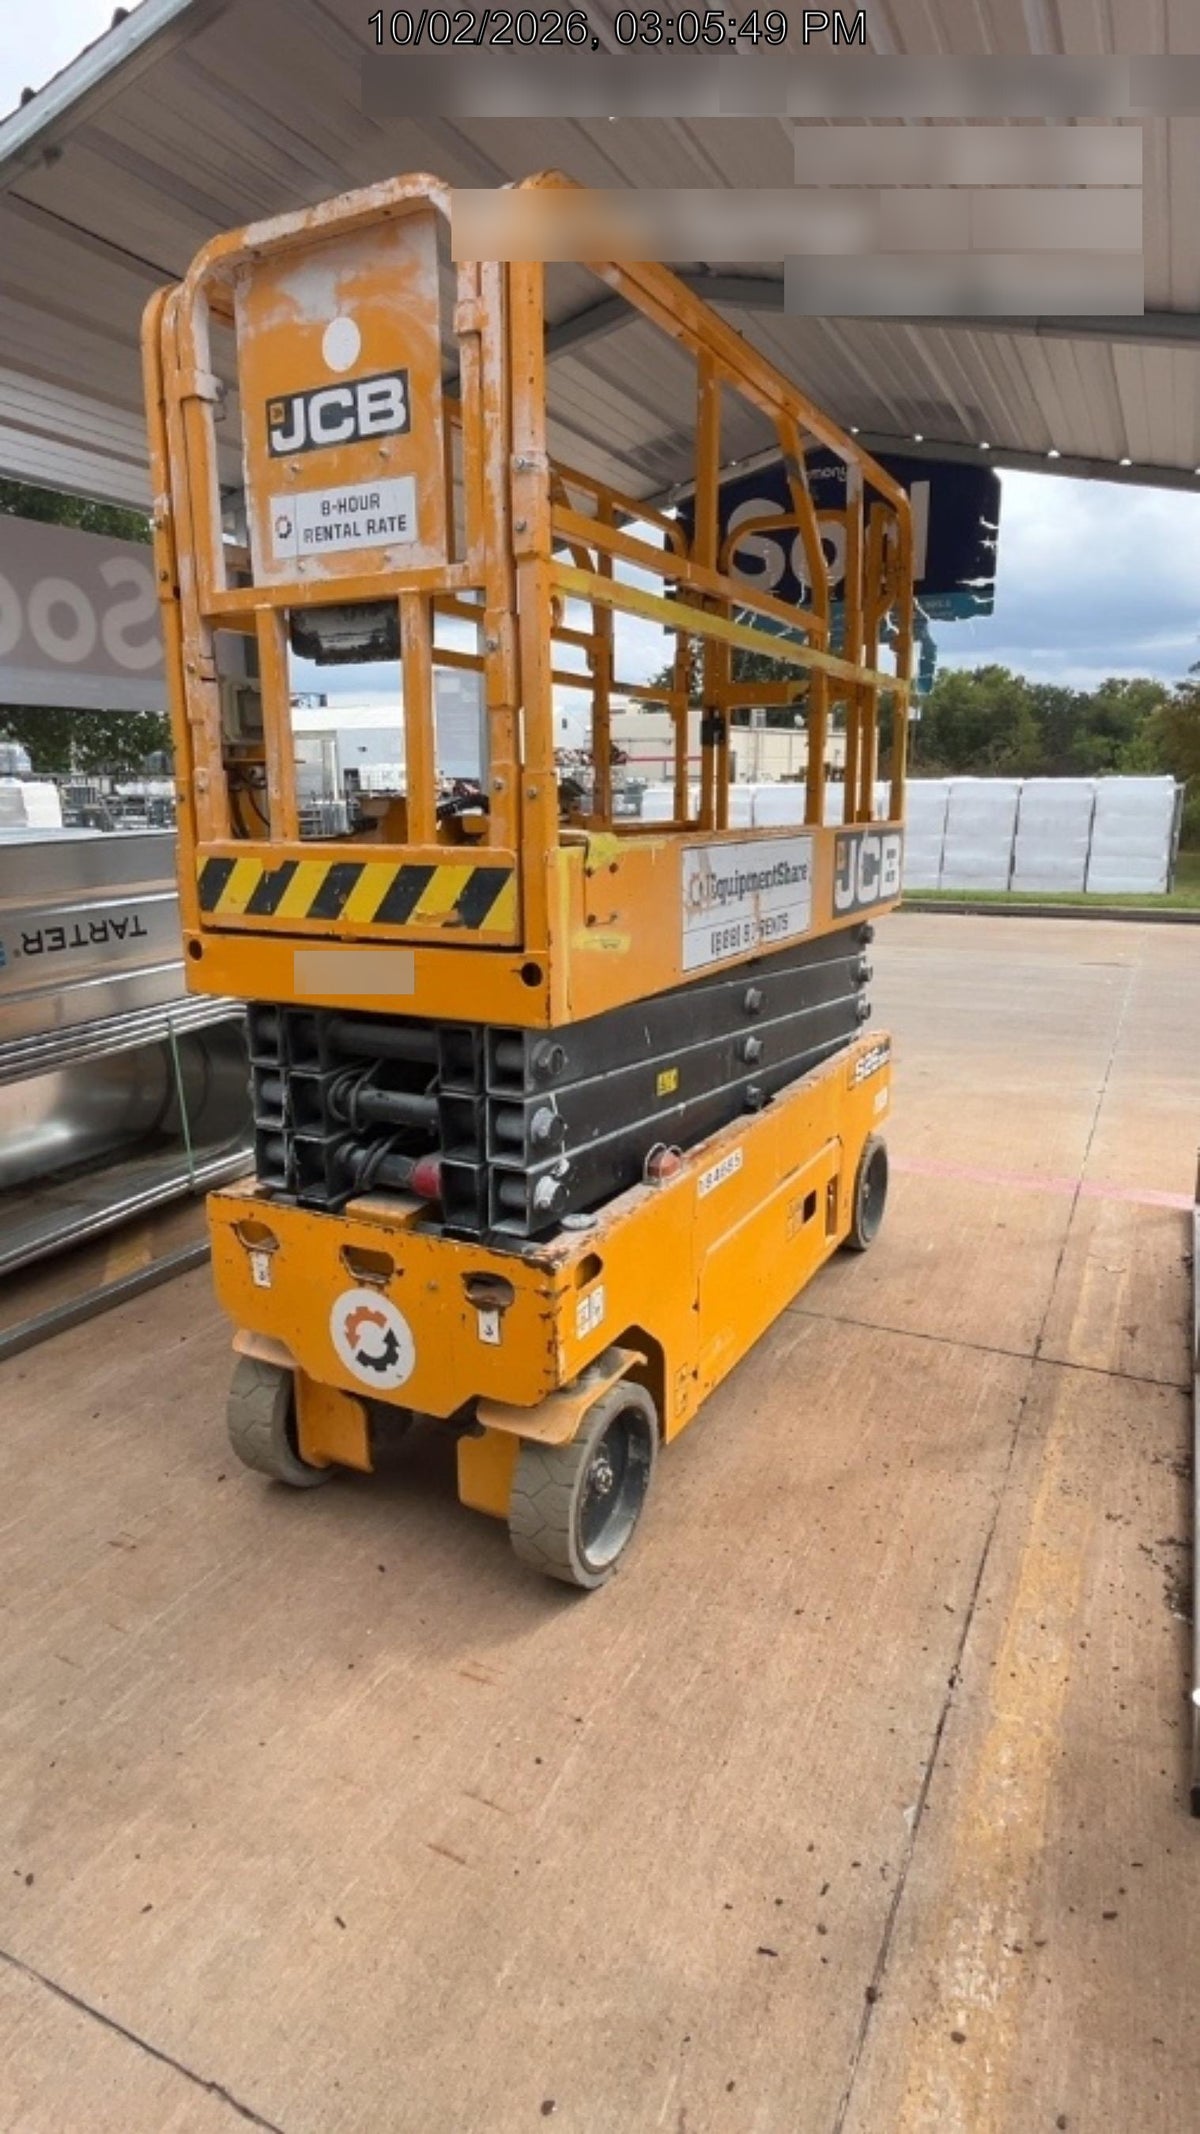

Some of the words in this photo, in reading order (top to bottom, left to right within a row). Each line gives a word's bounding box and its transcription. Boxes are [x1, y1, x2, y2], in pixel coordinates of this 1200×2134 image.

[271, 377, 407, 451] JCB
[321, 493, 380, 516] 8-HOUR
[303, 524, 361, 544] RENTAL
[367, 514, 407, 535] RATE
[834, 833, 900, 910] JCB
[21, 914, 148, 956] TARTER
